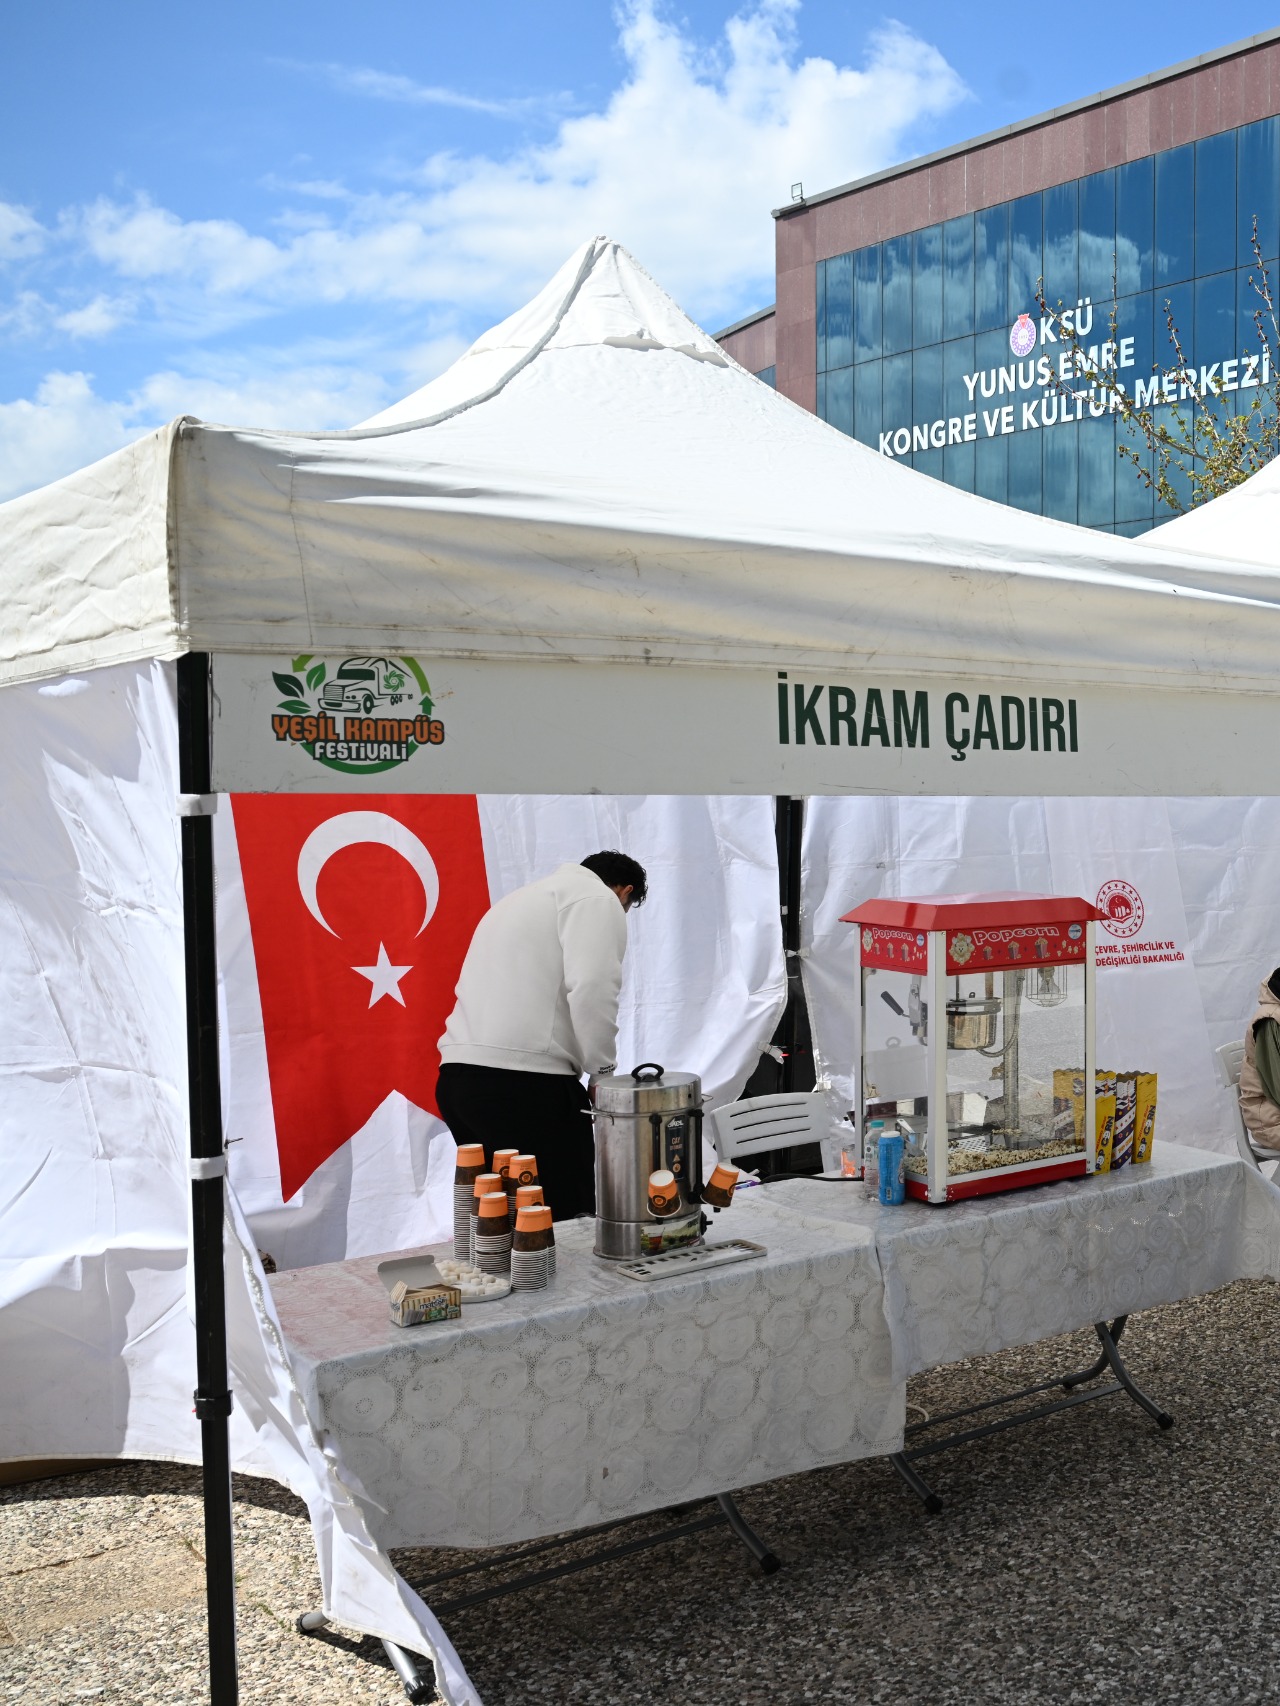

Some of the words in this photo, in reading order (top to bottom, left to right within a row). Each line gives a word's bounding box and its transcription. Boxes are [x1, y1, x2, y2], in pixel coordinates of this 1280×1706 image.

[1040, 297, 1093, 345] KSÜ
[963, 355, 1050, 401] YUNUS
[1059, 336, 1135, 382] EMRE
[879, 414, 977, 456] KONGRE
[983, 404, 1015, 437] VE
[1022, 380, 1126, 429] KÜLTÜR
[1135, 343, 1270, 409] MERKEZİ
[271, 711, 340, 743] YEŞİL
[344, 714, 445, 745] KAMPÜS
[778, 671, 930, 749] İKRAM
[944, 692, 1079, 762] ÇADIRI
[872, 927, 914, 942] Popcorn
[972, 926, 1060, 945] Popcorn
[1122, 940, 1164, 955] ŞEHİRCİLİK
[1164, 941, 1175, 950] VE
